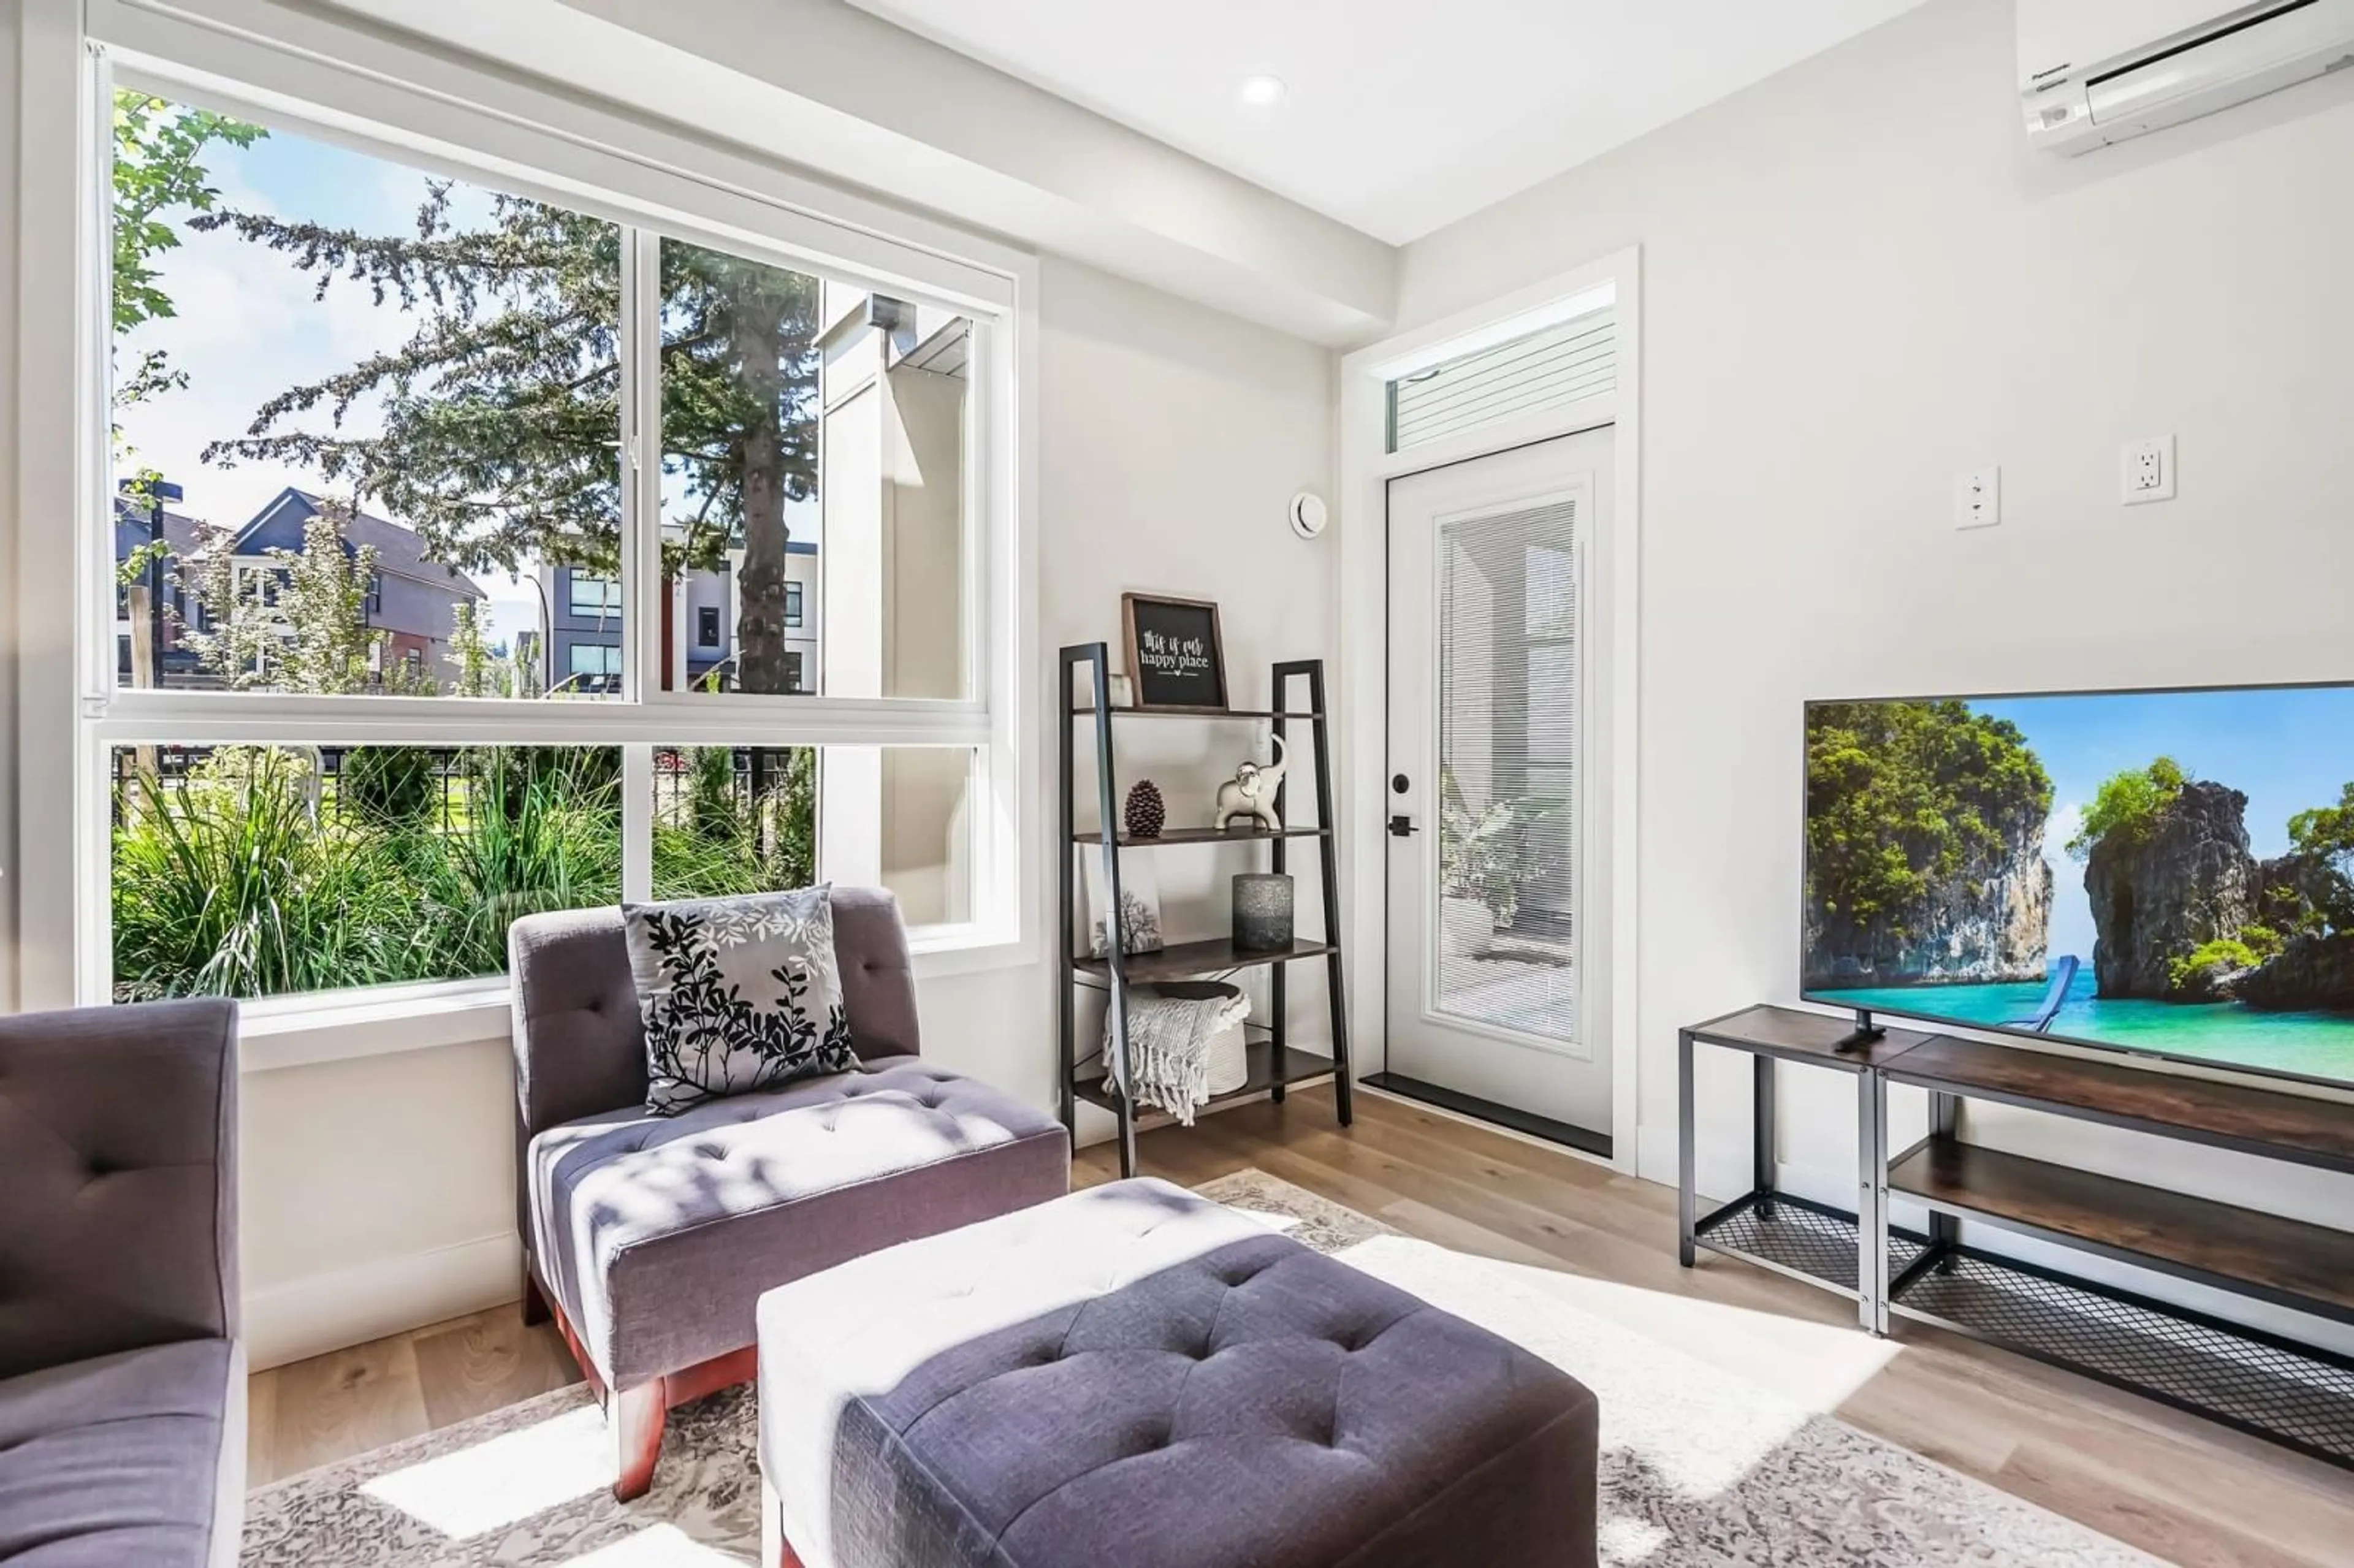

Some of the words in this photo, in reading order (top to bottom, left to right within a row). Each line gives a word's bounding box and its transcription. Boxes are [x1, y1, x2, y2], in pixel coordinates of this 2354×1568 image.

[1169, 636, 1180, 656] is
[1140, 649, 1176, 669] happy
[1178, 653, 1209, 669] place
